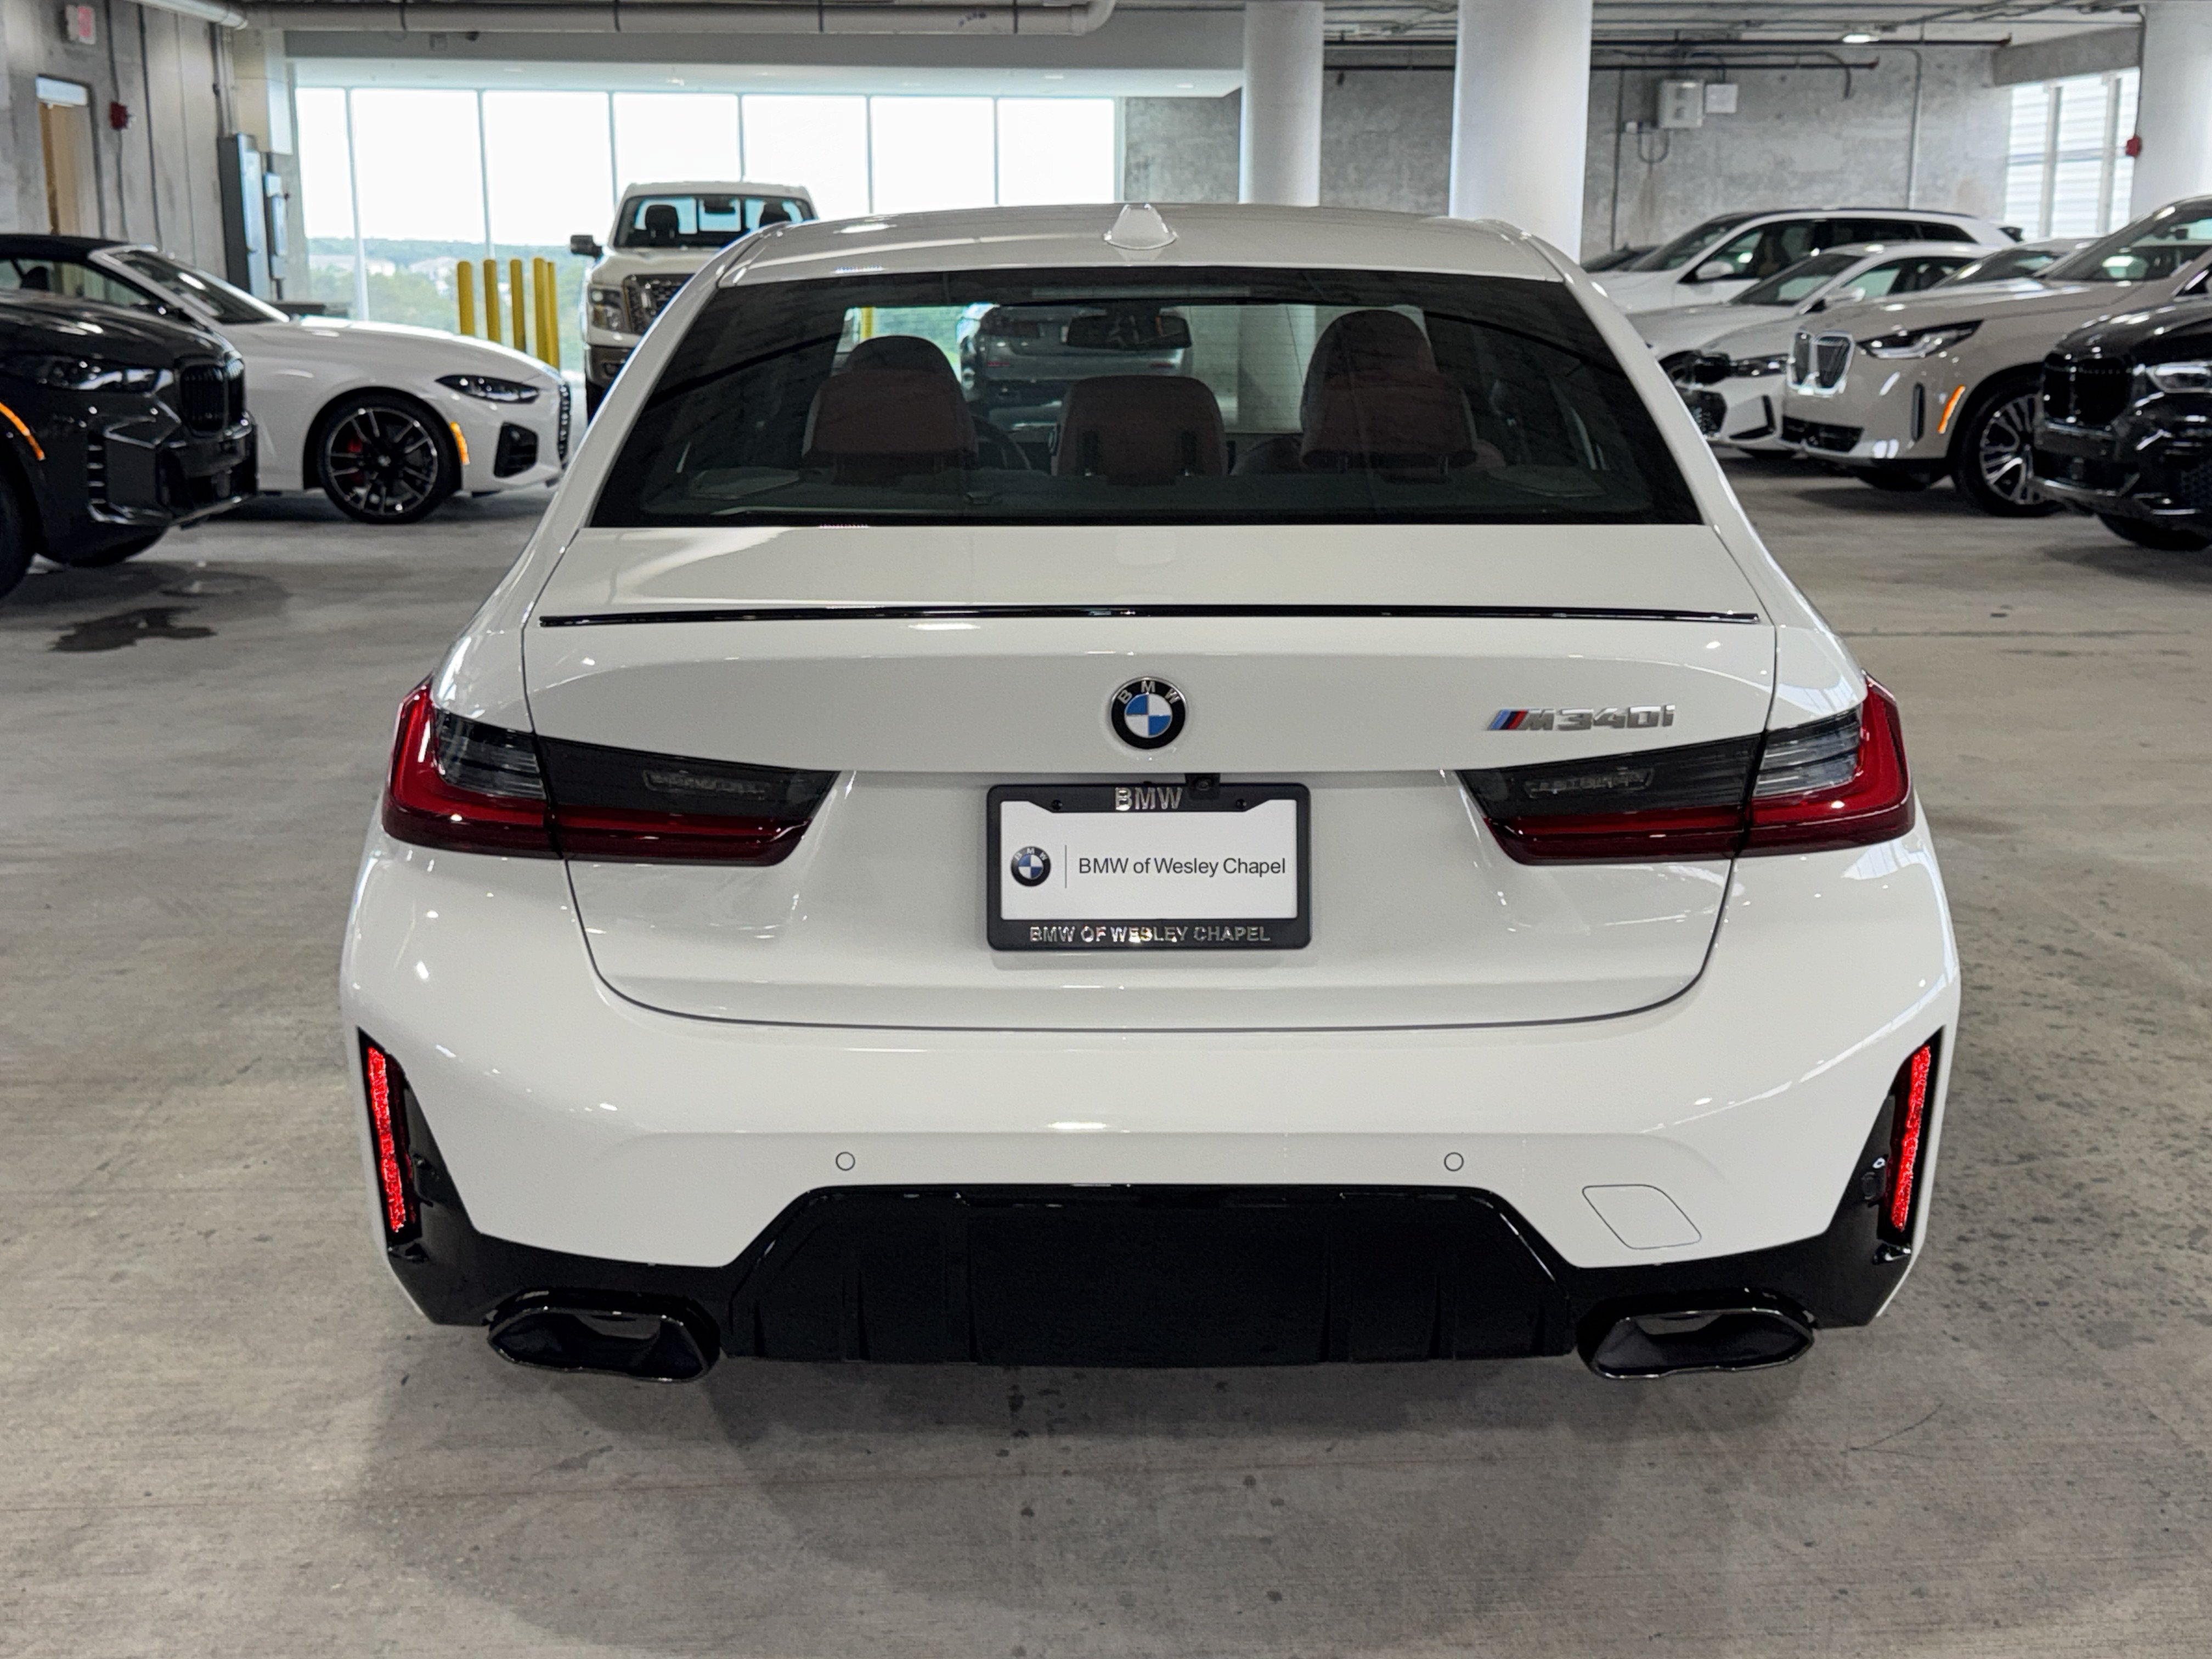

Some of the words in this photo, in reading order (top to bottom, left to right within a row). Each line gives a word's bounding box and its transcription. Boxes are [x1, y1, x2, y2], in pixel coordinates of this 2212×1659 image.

[1118, 680, 1181, 704] BMW
[1517, 705, 1675, 731] M340i
[1115, 787, 1182, 811] BMW
[1014, 848, 1048, 861] BMW
[1079, 857, 1128, 874] BMW
[1133, 857, 1151, 874] of
[1154, 857, 1218, 878] Wesley
[1223, 857, 1285, 878] Chapel
[1030, 926, 1075, 942] BMW
[1080, 926, 1106, 943] OF
[1110, 926, 1188, 943] WESLEY
[1193, 926, 1271, 943] CHAPEL
